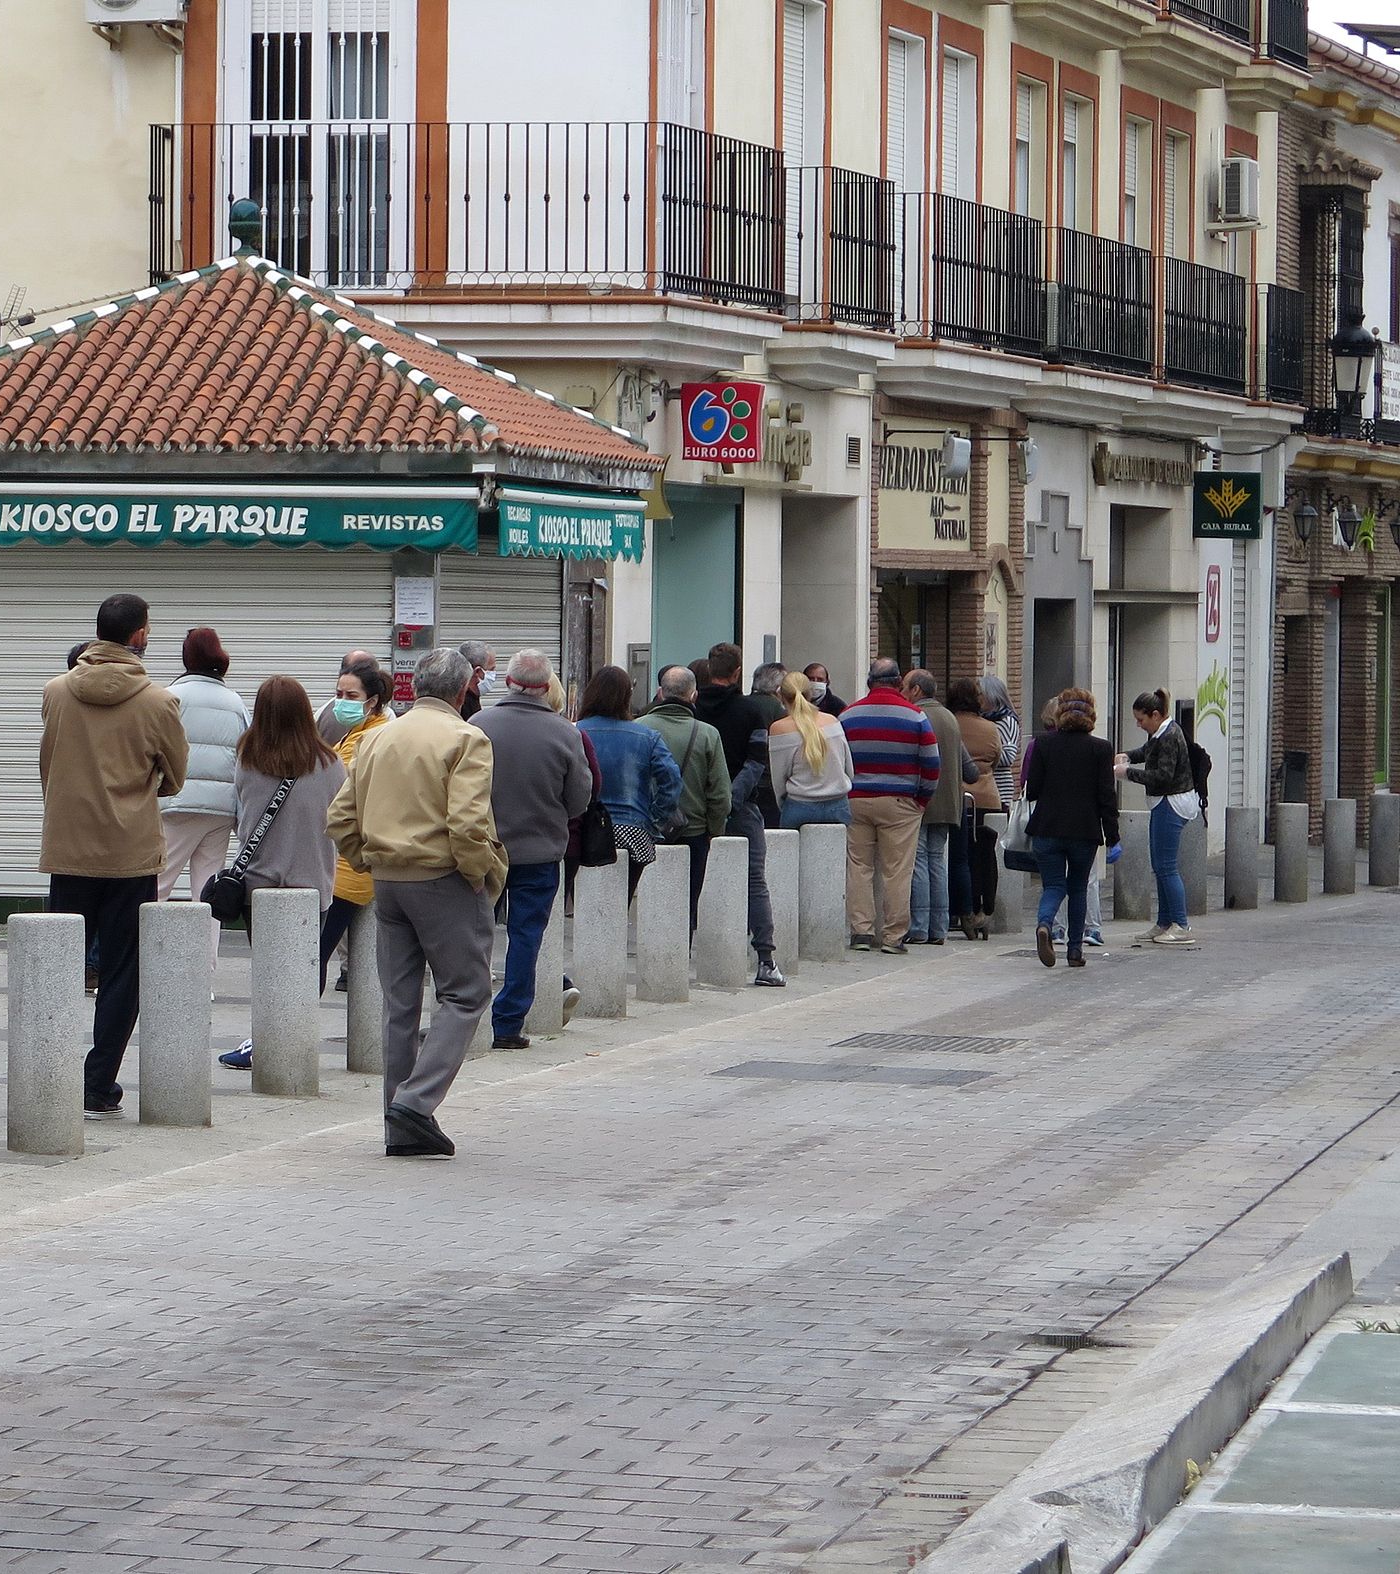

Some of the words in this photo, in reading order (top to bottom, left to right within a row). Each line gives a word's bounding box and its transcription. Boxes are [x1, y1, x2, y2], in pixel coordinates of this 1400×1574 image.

[684, 446, 718, 458] EURO
[721, 447, 756, 459] 6000
[0, 503, 119, 533] KIOSCO
[127, 504, 163, 533] EL
[173, 504, 310, 536] PARQUE
[342, 514, 444, 532] REVISTAS
[934, 518, 968, 541] NATURAL
[1201, 522, 1221, 531] CAJA
[1223, 523, 1252, 531] RURAL
[539, 515, 569, 544] KIOSCO
[570, 517, 580, 545] EL
[581, 518, 613, 548] PARQUE
[270, 785, 288, 809] LOLA
[250, 813, 272, 841] BIMBA
